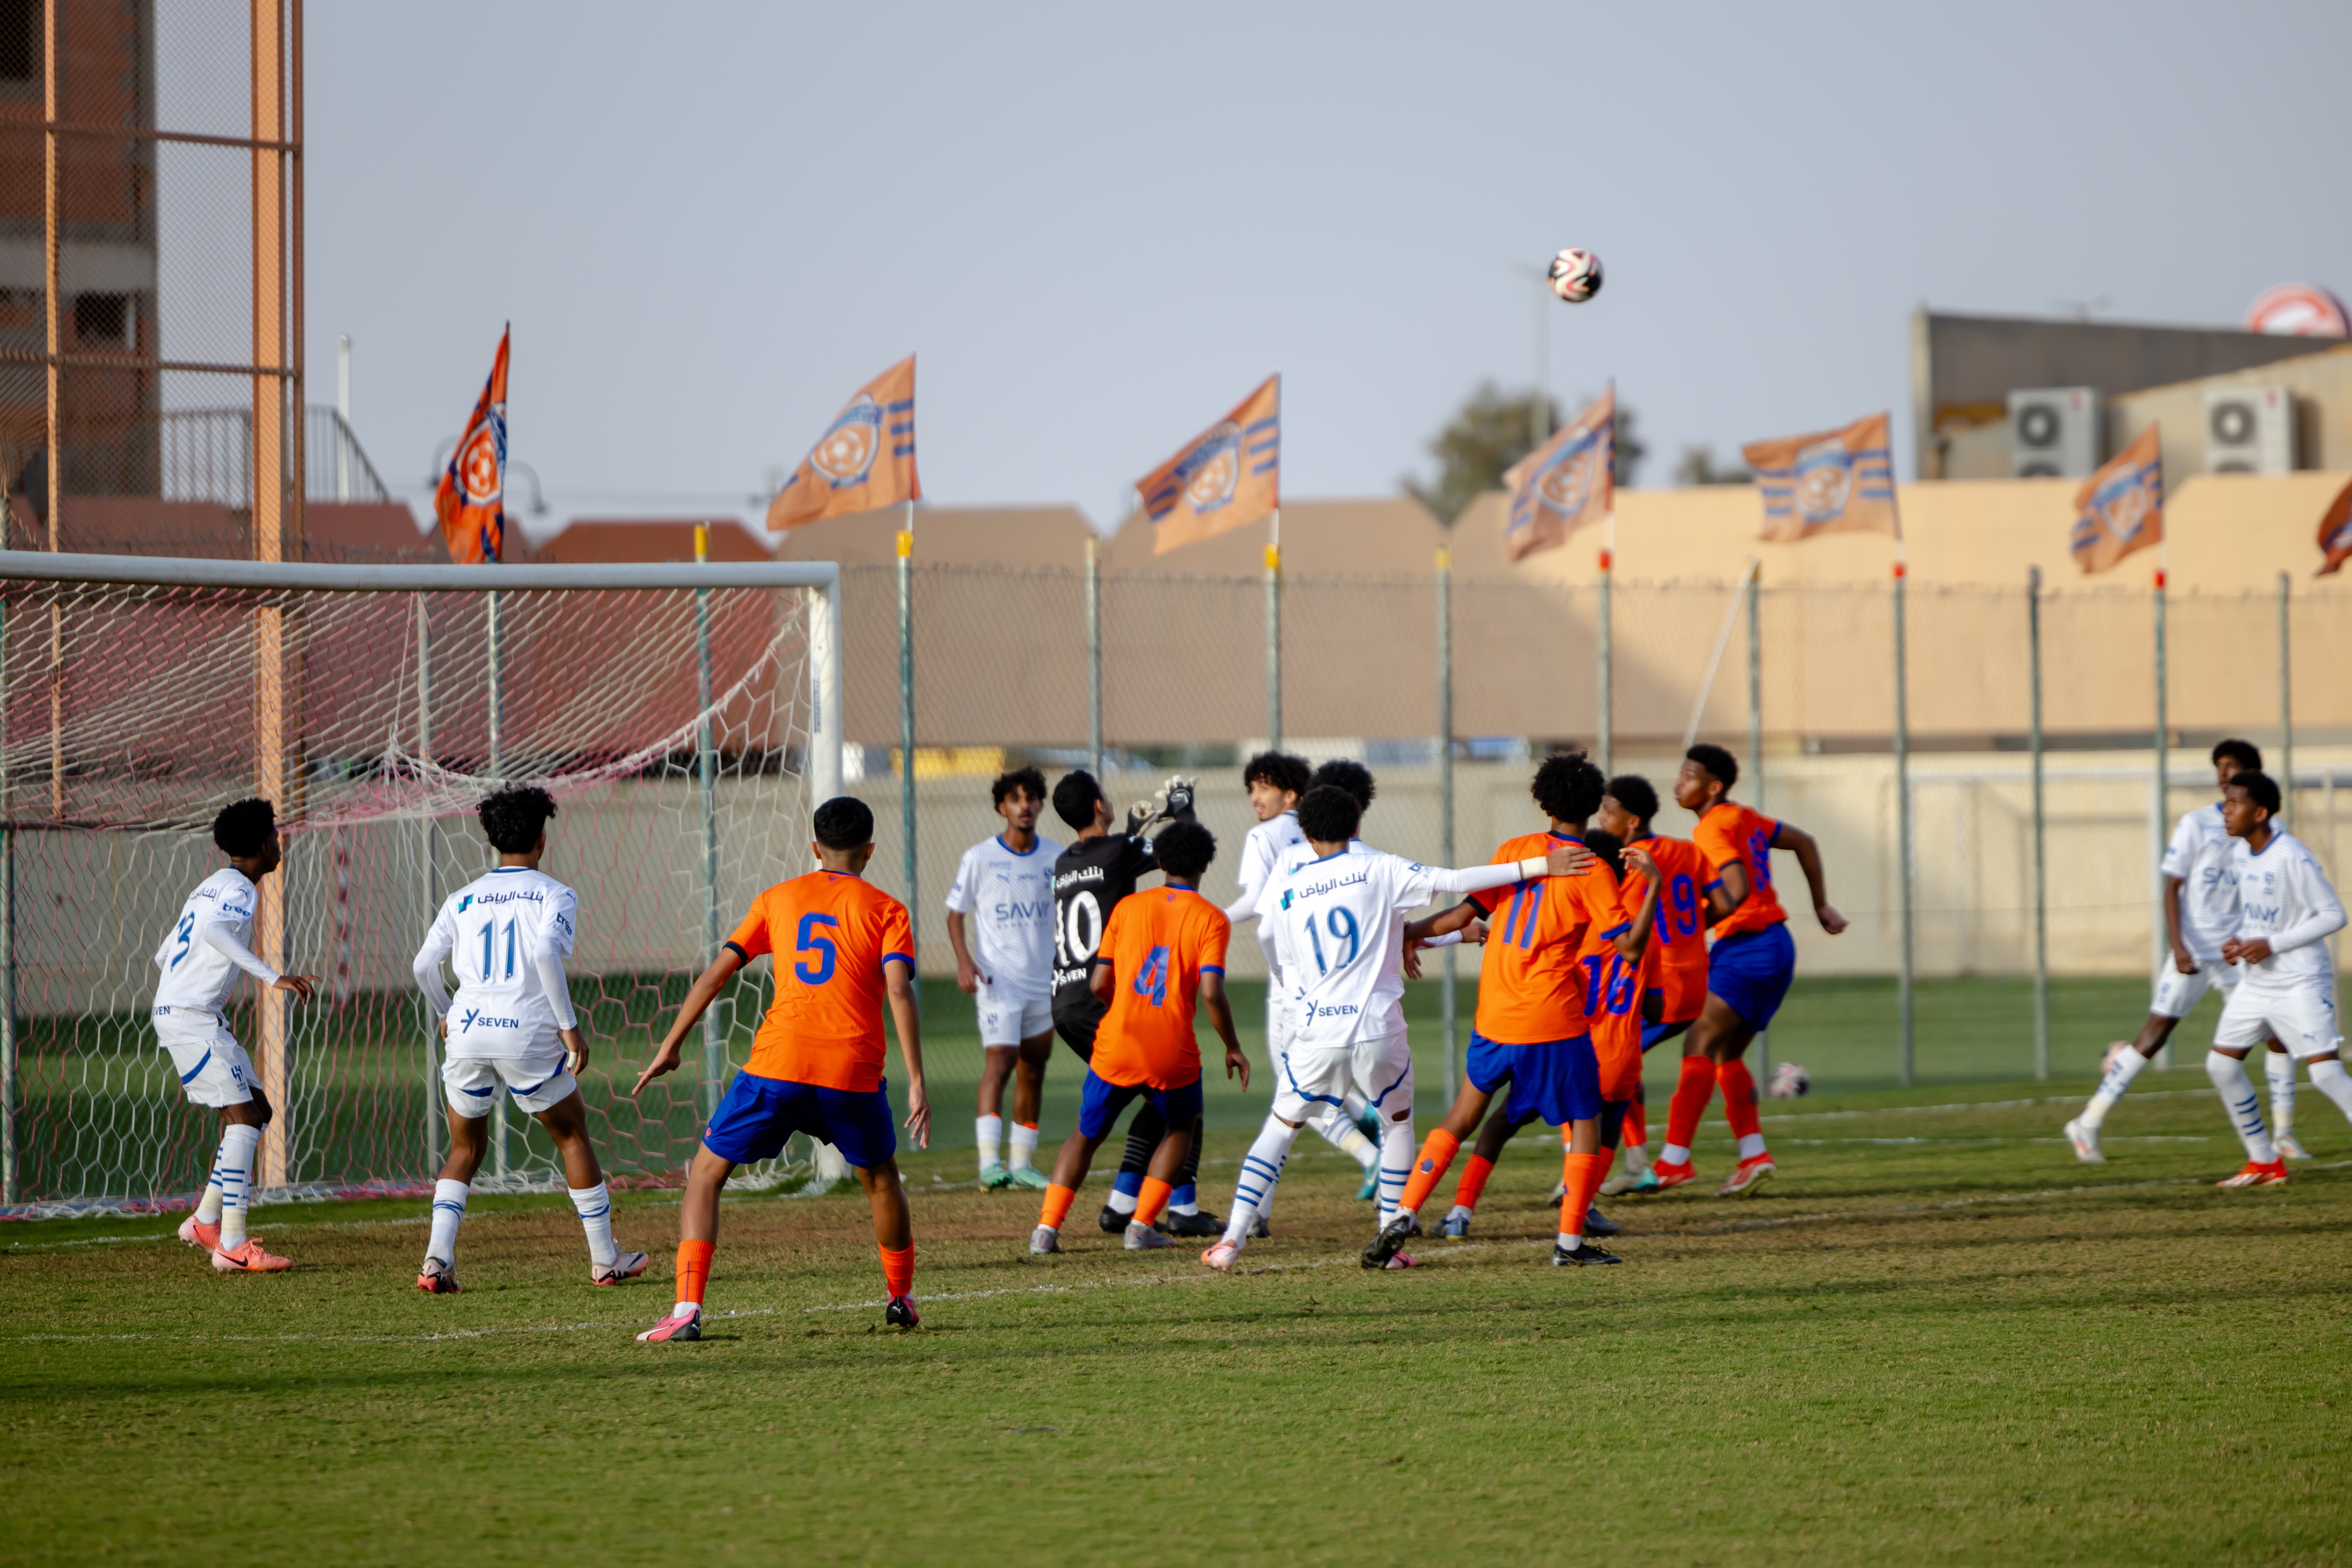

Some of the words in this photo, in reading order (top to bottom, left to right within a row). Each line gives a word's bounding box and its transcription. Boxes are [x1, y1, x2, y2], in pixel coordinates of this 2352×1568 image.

[1299, 878, 1337, 898] الرياض
[1339, 872, 1367, 886] بنك
[477, 891, 516, 904] الرياض
[517, 891, 544, 904] بنك
[223, 902, 251, 917] tree
[1502, 879, 1546, 950] 11
[477, 914, 516, 983] 11
[795, 911, 839, 986] 5
[1303, 904, 1361, 978] 19
[1132, 944, 1171, 1008] 4
[1581, 953, 1637, 1017] 16
[1318, 1004, 1358, 1017] SEVEN
[477, 1016, 519, 1029] SEVEN
